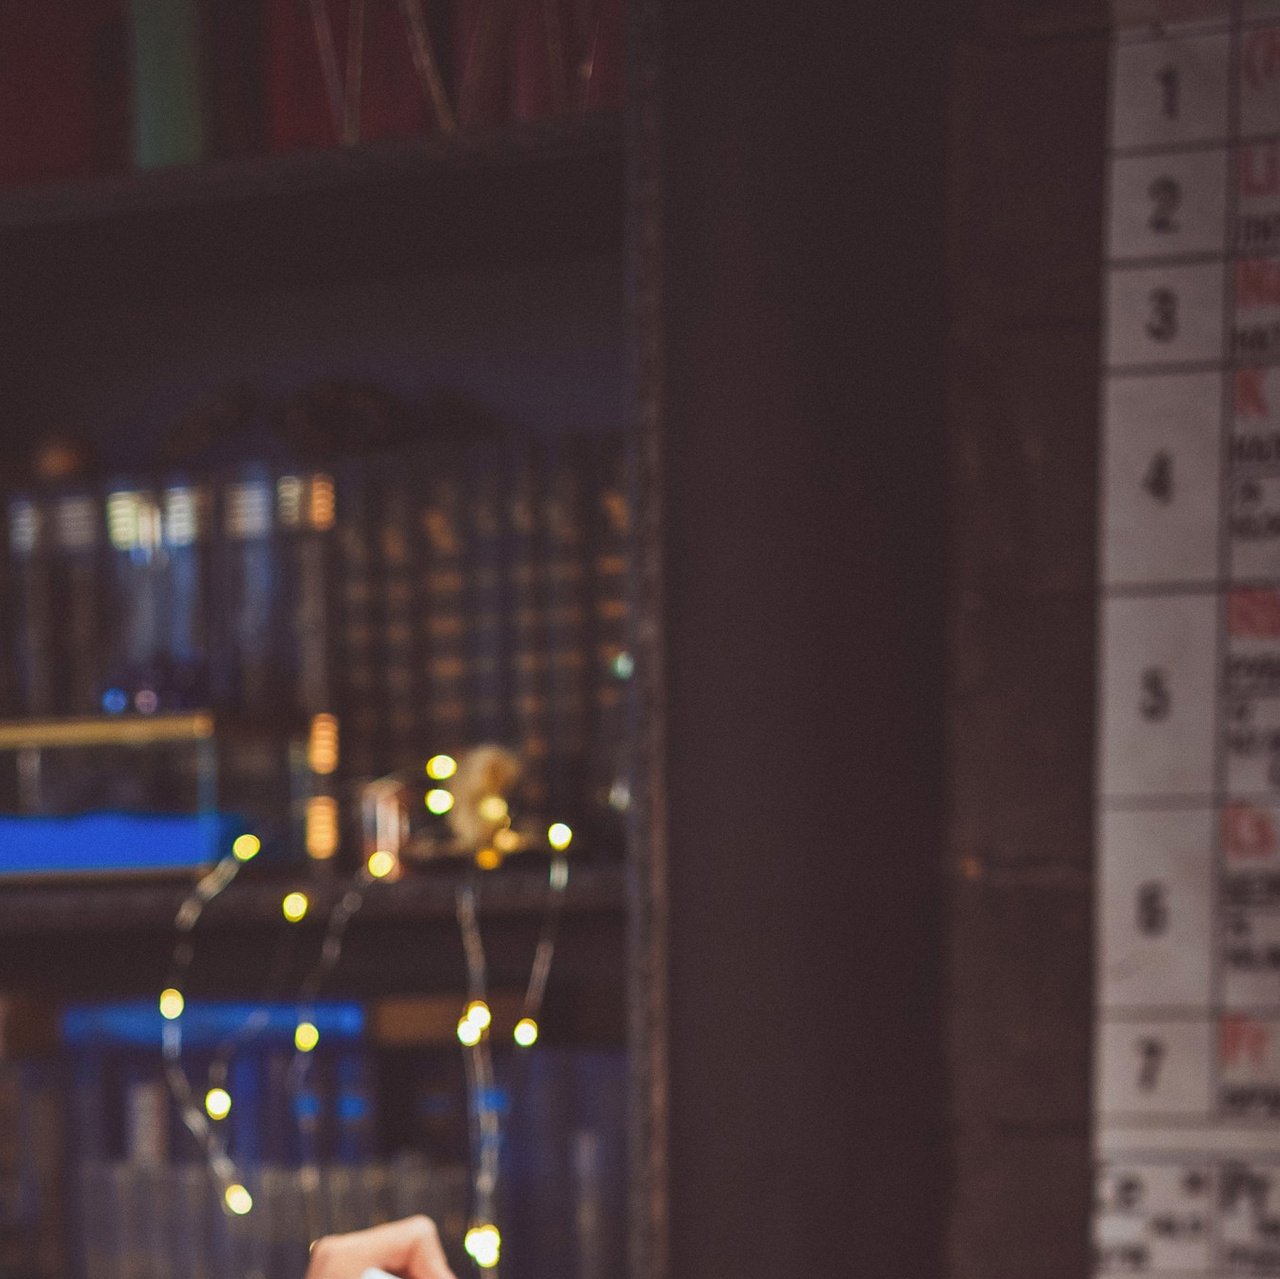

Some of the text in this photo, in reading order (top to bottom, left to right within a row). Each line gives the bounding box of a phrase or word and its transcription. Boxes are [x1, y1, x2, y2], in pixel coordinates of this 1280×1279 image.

[1154, 62, 1181, 121] 1
[1148, 174, 1183, 235] 2
[1145, 286, 1180, 344] 3
[1141, 449, 1176, 506] 4
[1140, 665, 1173, 725] 5
[1135, 880, 1169, 938] 6
